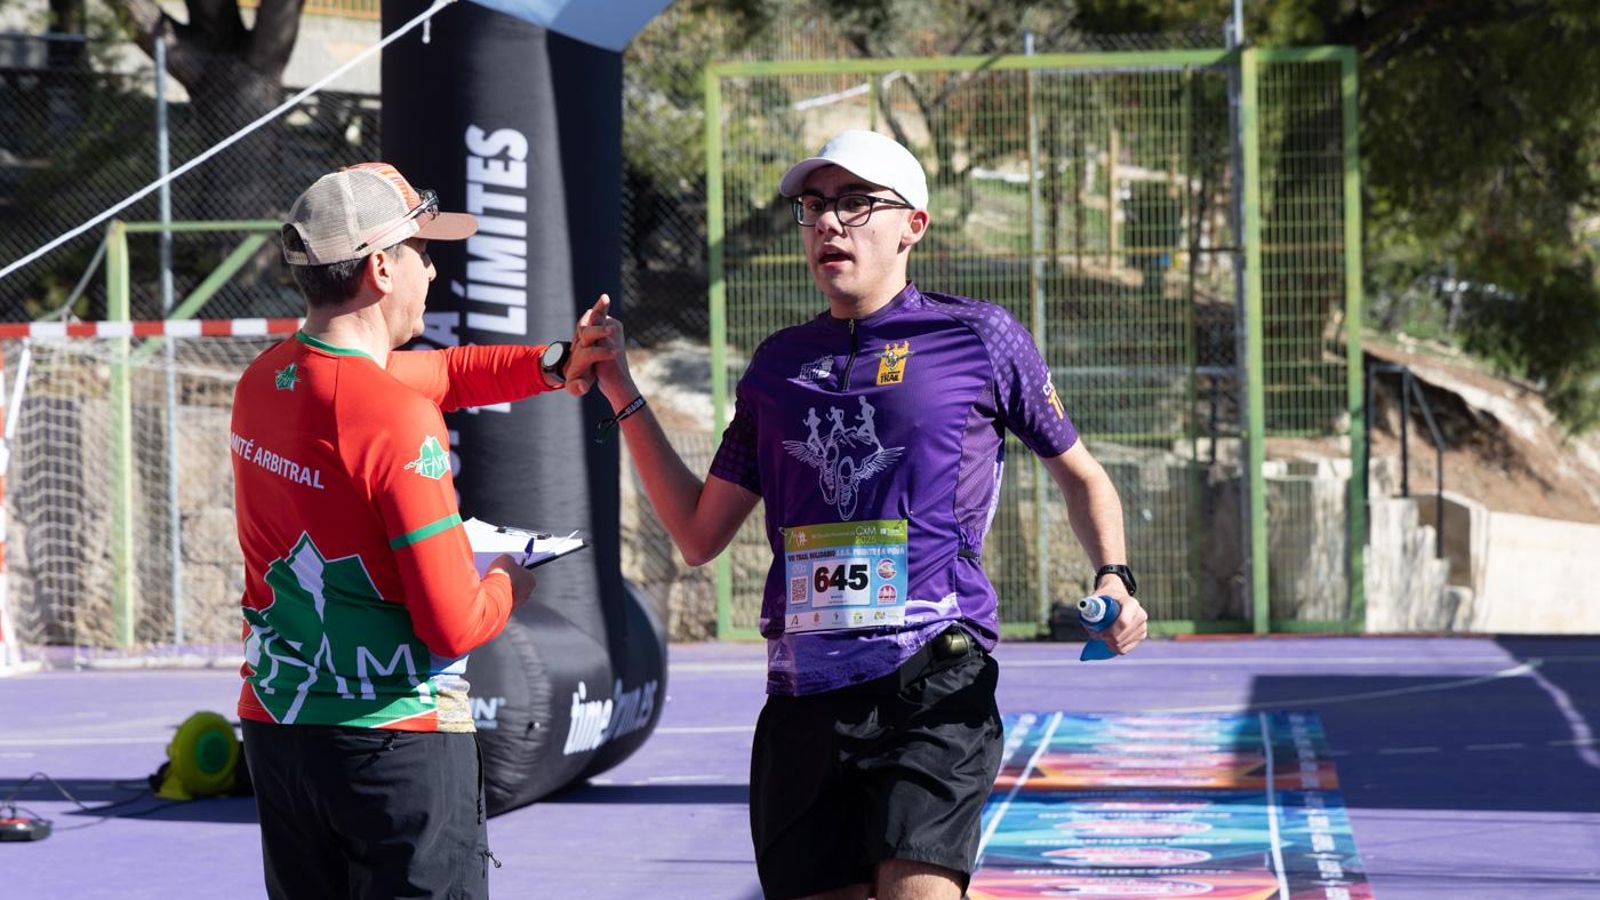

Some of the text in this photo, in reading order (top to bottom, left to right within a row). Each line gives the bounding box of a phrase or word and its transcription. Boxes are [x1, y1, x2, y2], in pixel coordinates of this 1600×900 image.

[451, 124, 529, 335] LÍMITES
[231, 432, 325, 490] MITÉ ARBITRAL
[814, 564, 869, 594] 645
